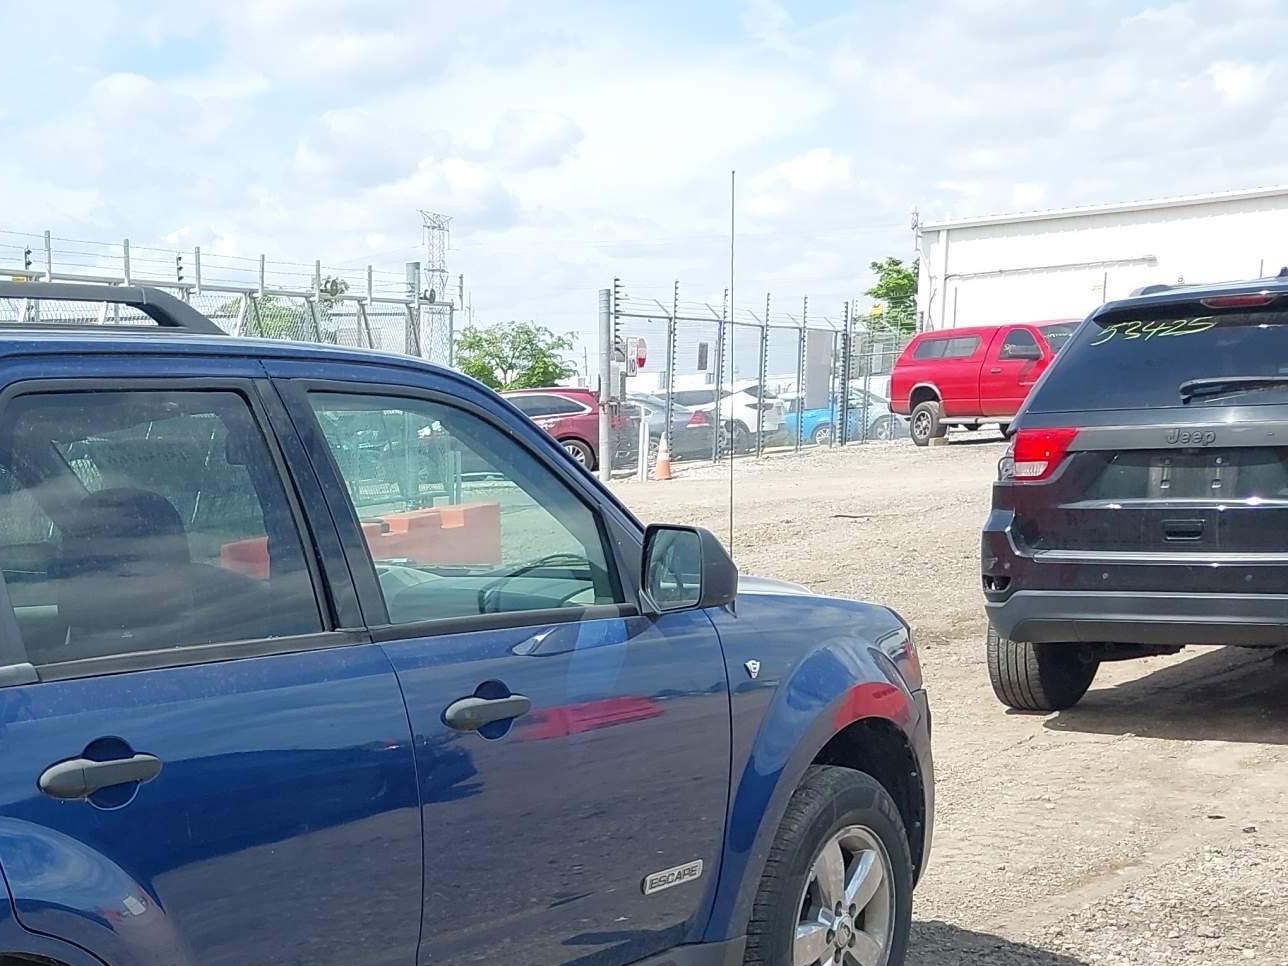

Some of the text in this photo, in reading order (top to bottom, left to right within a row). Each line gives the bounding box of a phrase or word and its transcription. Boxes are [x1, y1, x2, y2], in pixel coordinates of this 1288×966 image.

[1090, 315, 1217, 346] 53425
[1167, 428, 1216, 446] Jeep
[649, 864, 699, 890] ESCAPE
